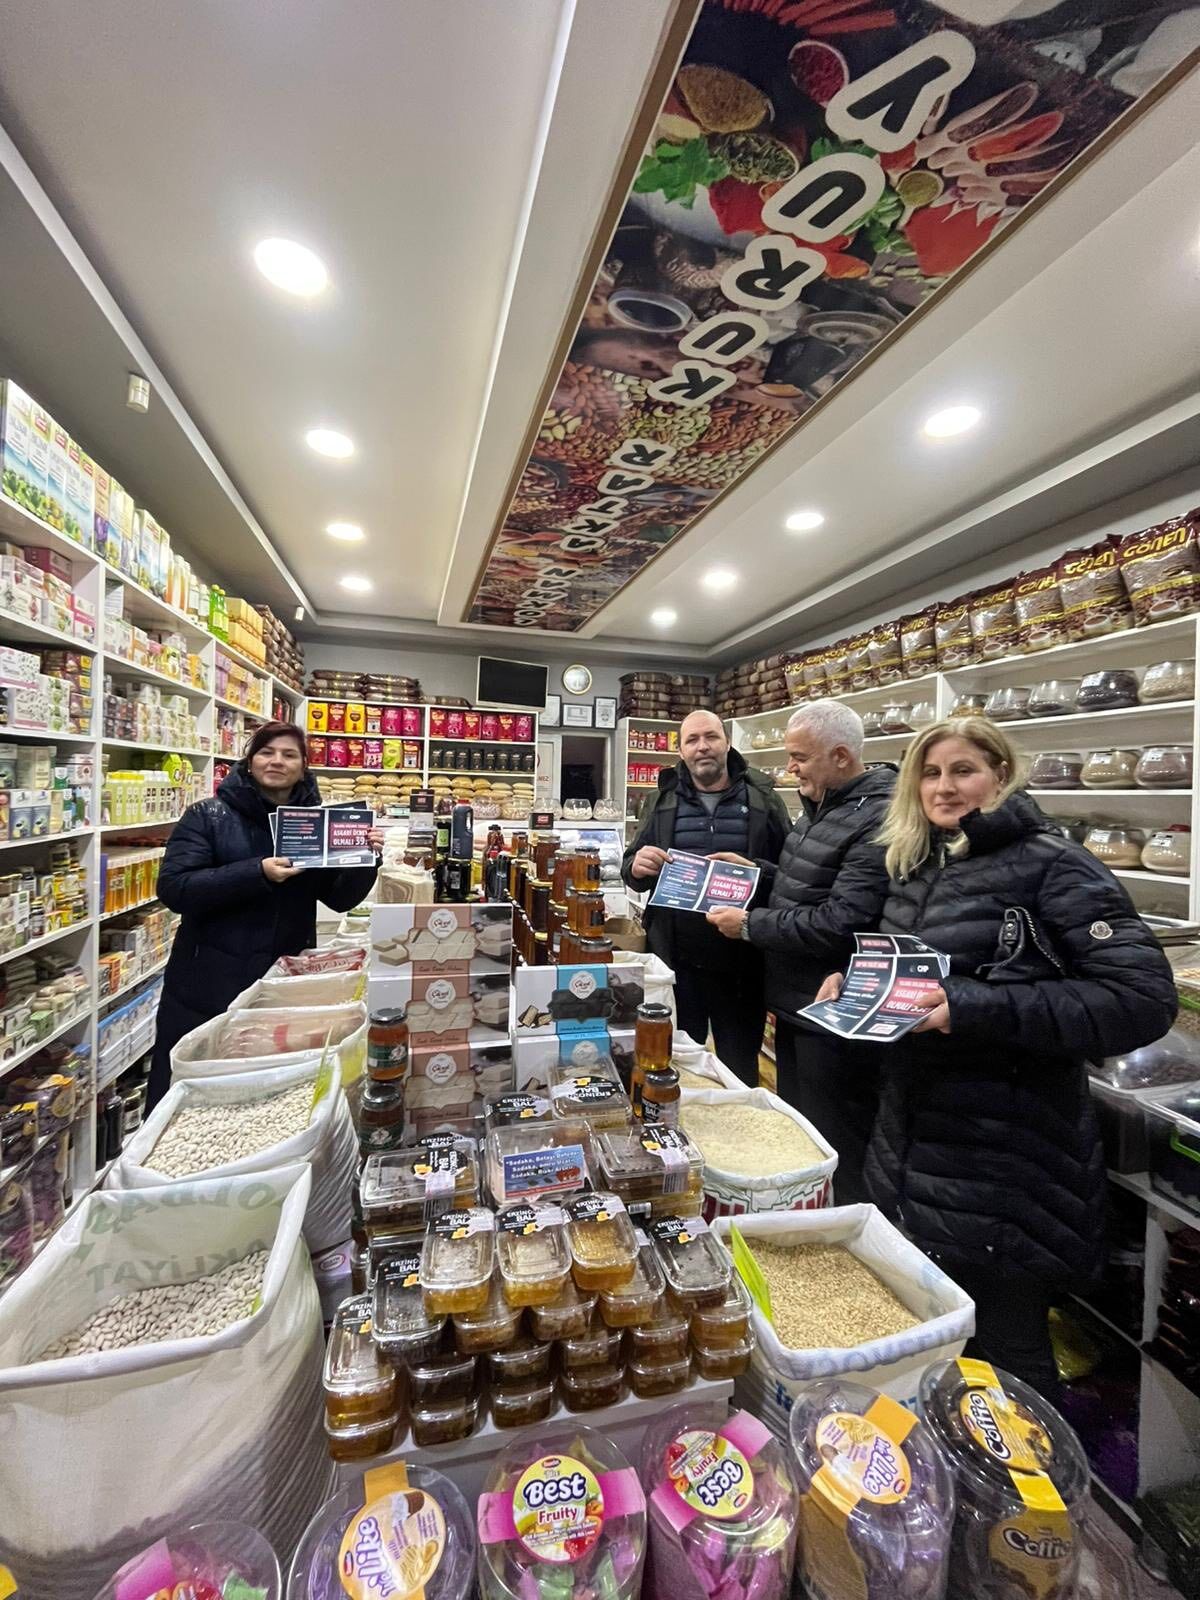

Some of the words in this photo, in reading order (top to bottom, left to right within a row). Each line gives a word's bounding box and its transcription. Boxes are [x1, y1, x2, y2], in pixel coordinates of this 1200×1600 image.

[390, 1258, 419, 1267] ERZİNC
[349, 1302, 372, 1311] ERZİN
[358, 1308, 372, 1317] BA
[692, 1451, 719, 1477] Fruity
[523, 1472, 586, 1508] Best
[697, 1459, 743, 1506] Best
[538, 1506, 577, 1523] Fruity
